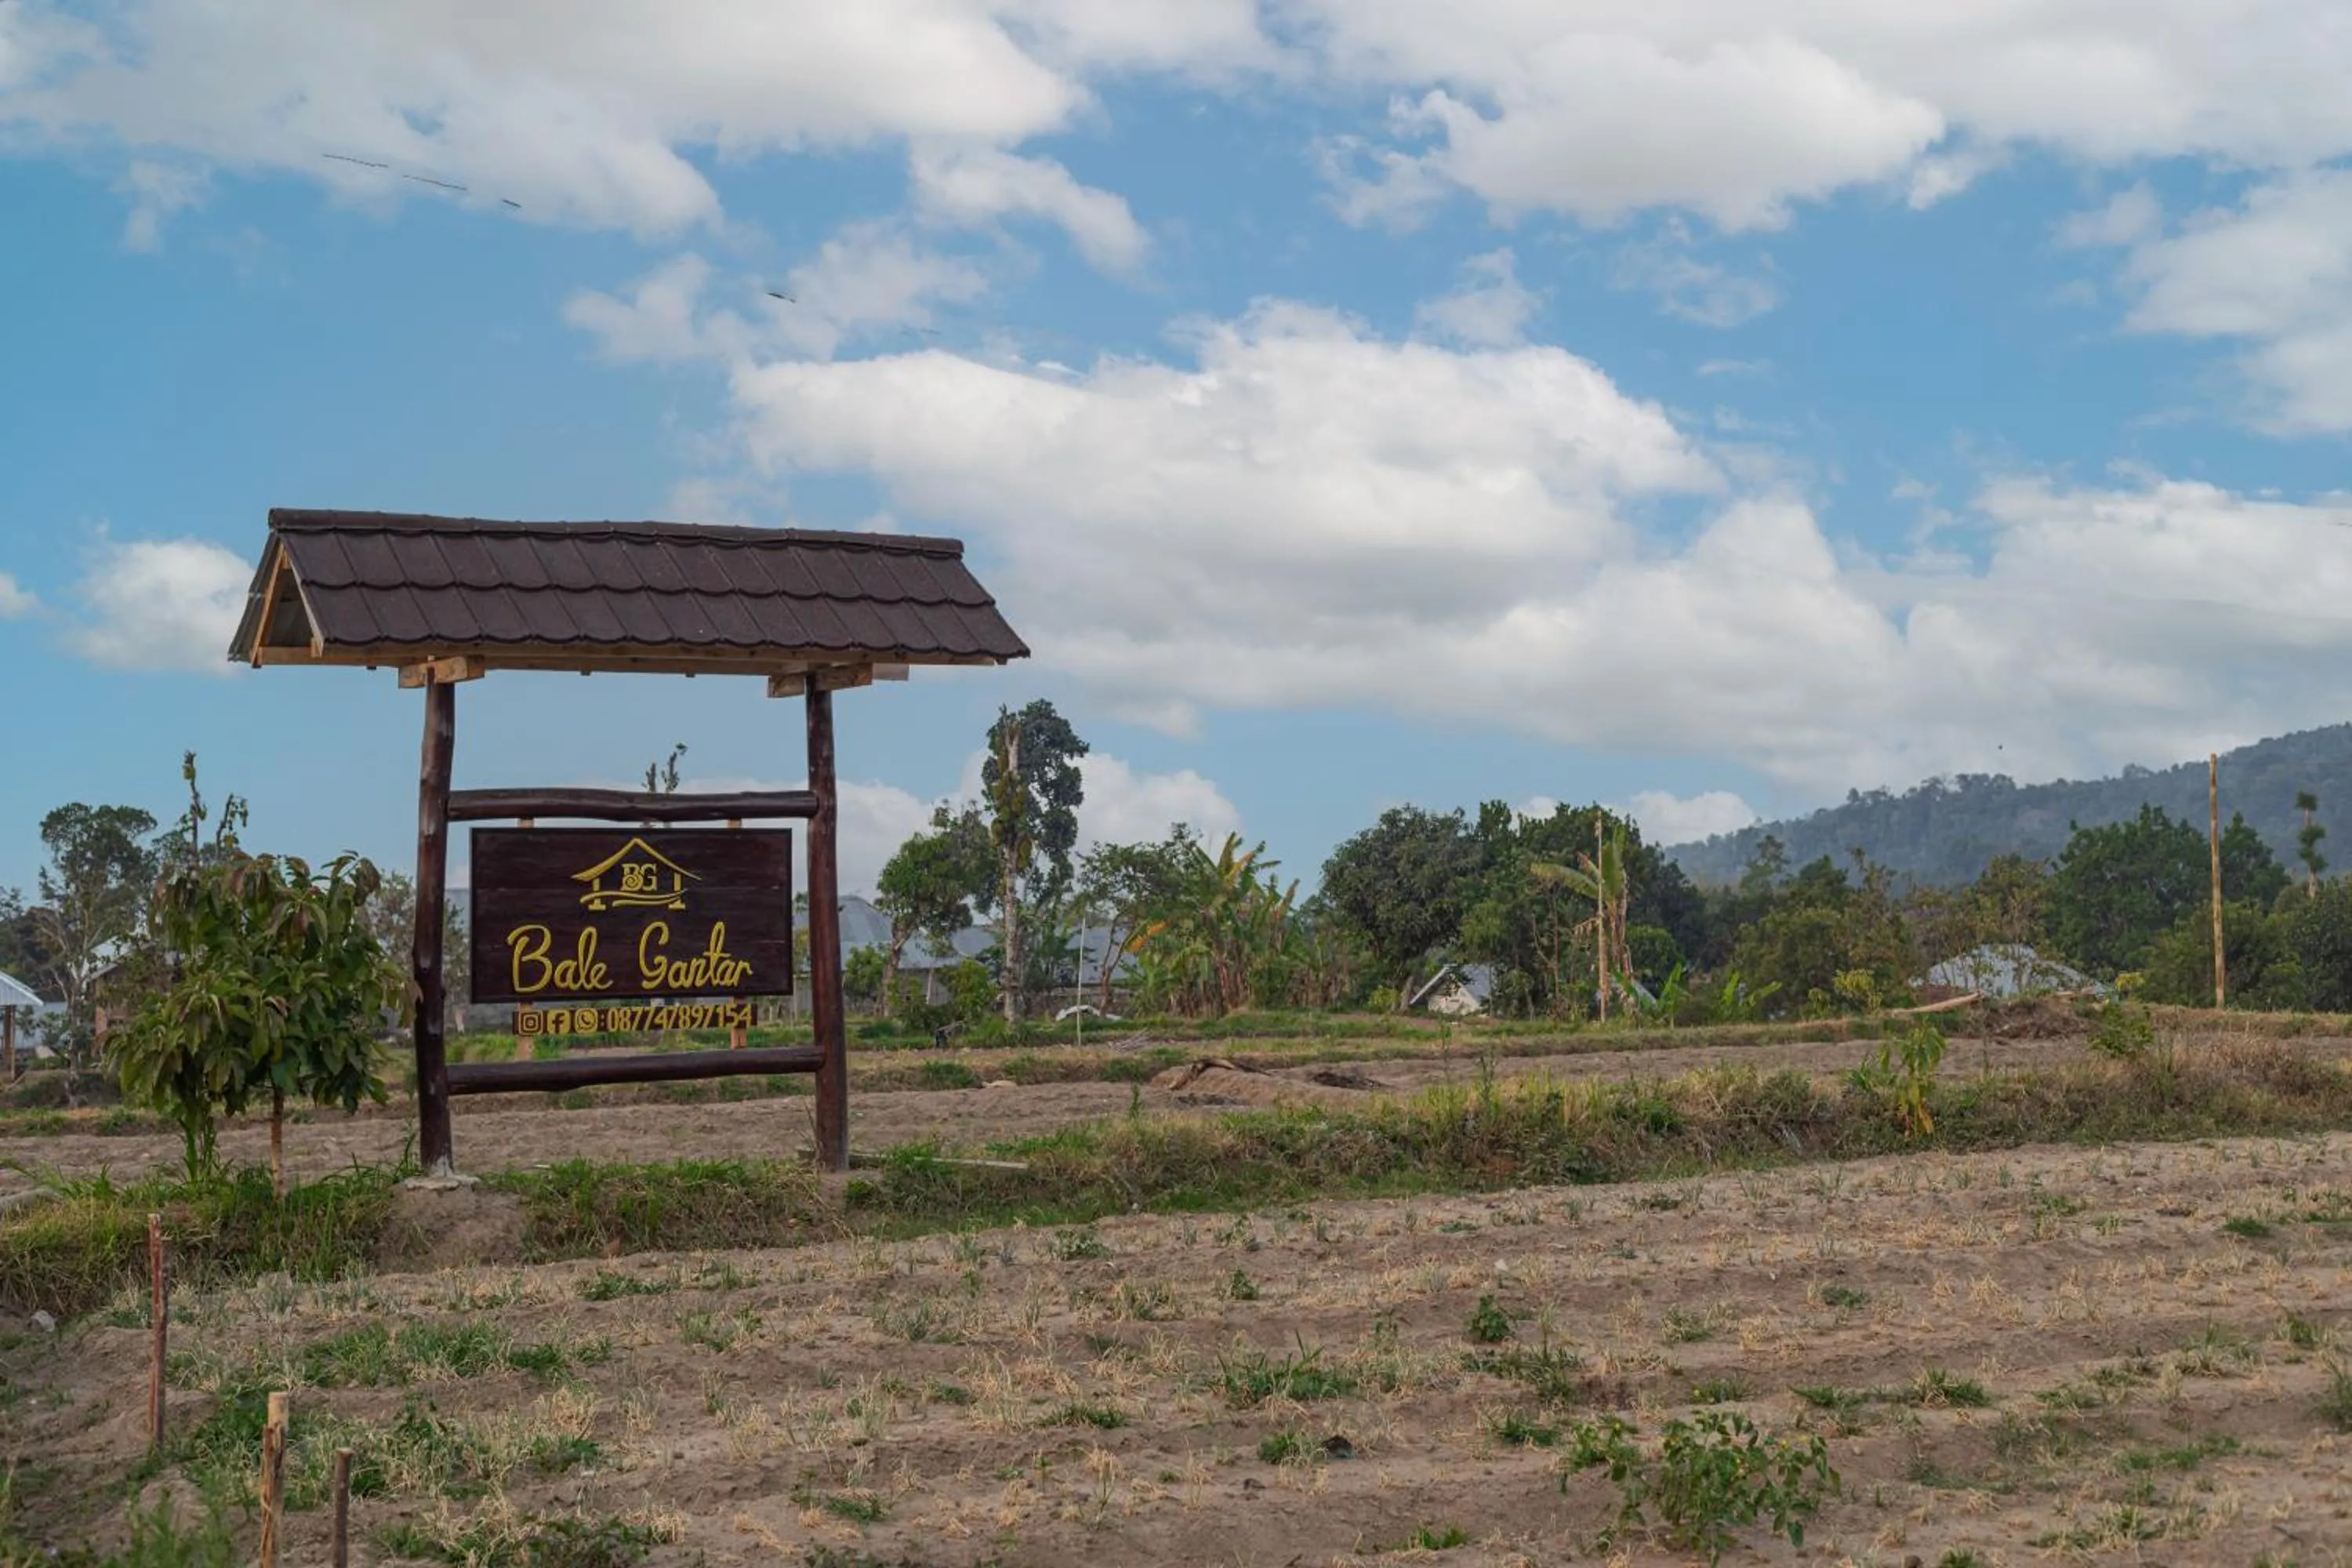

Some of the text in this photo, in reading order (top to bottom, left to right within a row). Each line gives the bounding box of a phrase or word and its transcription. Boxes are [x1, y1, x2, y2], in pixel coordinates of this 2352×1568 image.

[621, 863, 658, 891] BG
[506, 921, 753, 993] Bale Gantar
